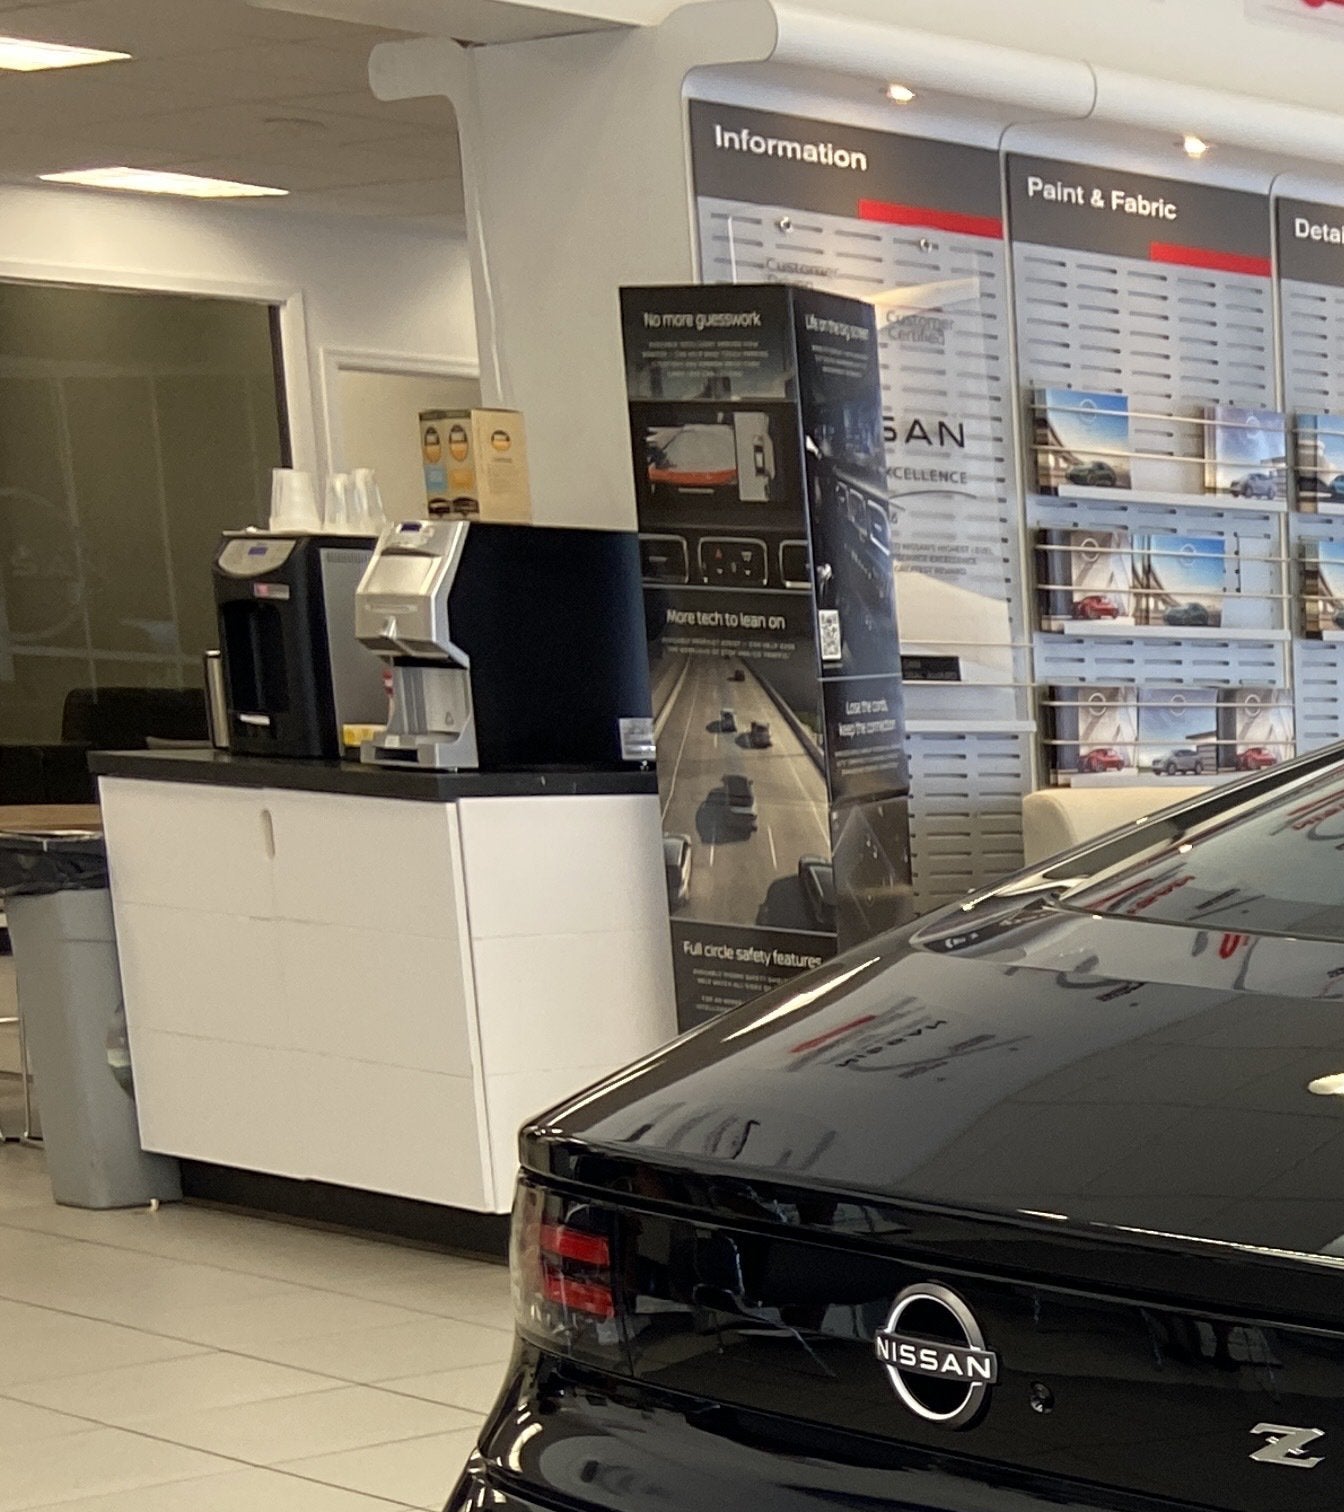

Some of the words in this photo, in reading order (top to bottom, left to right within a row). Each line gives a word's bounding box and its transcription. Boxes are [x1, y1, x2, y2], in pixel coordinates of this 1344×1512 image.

[715, 125, 867, 171] Information
[1027, 176, 1084, 205] Paint
[1090, 188, 1104, 208] &
[1111, 190, 1177, 220] Fabric
[644, 312, 661, 328] No
[662, 313, 693, 328] more
[695, 311, 761, 331] guesswork
[883, 415, 965, 449] SAN
[887, 467, 967, 484] XCELLENCE
[667, 609, 696, 625] More
[697, 611, 723, 627] tech
[725, 613, 739, 628] to
[740, 612, 766, 629] lean
[768, 616, 786, 630] on
[683, 940, 703, 956] Full
[704, 944, 734, 961] circle
[736, 946, 771, 967] safety
[772, 949, 823, 969] features
[876, 1336, 992, 1379] NISSAN
